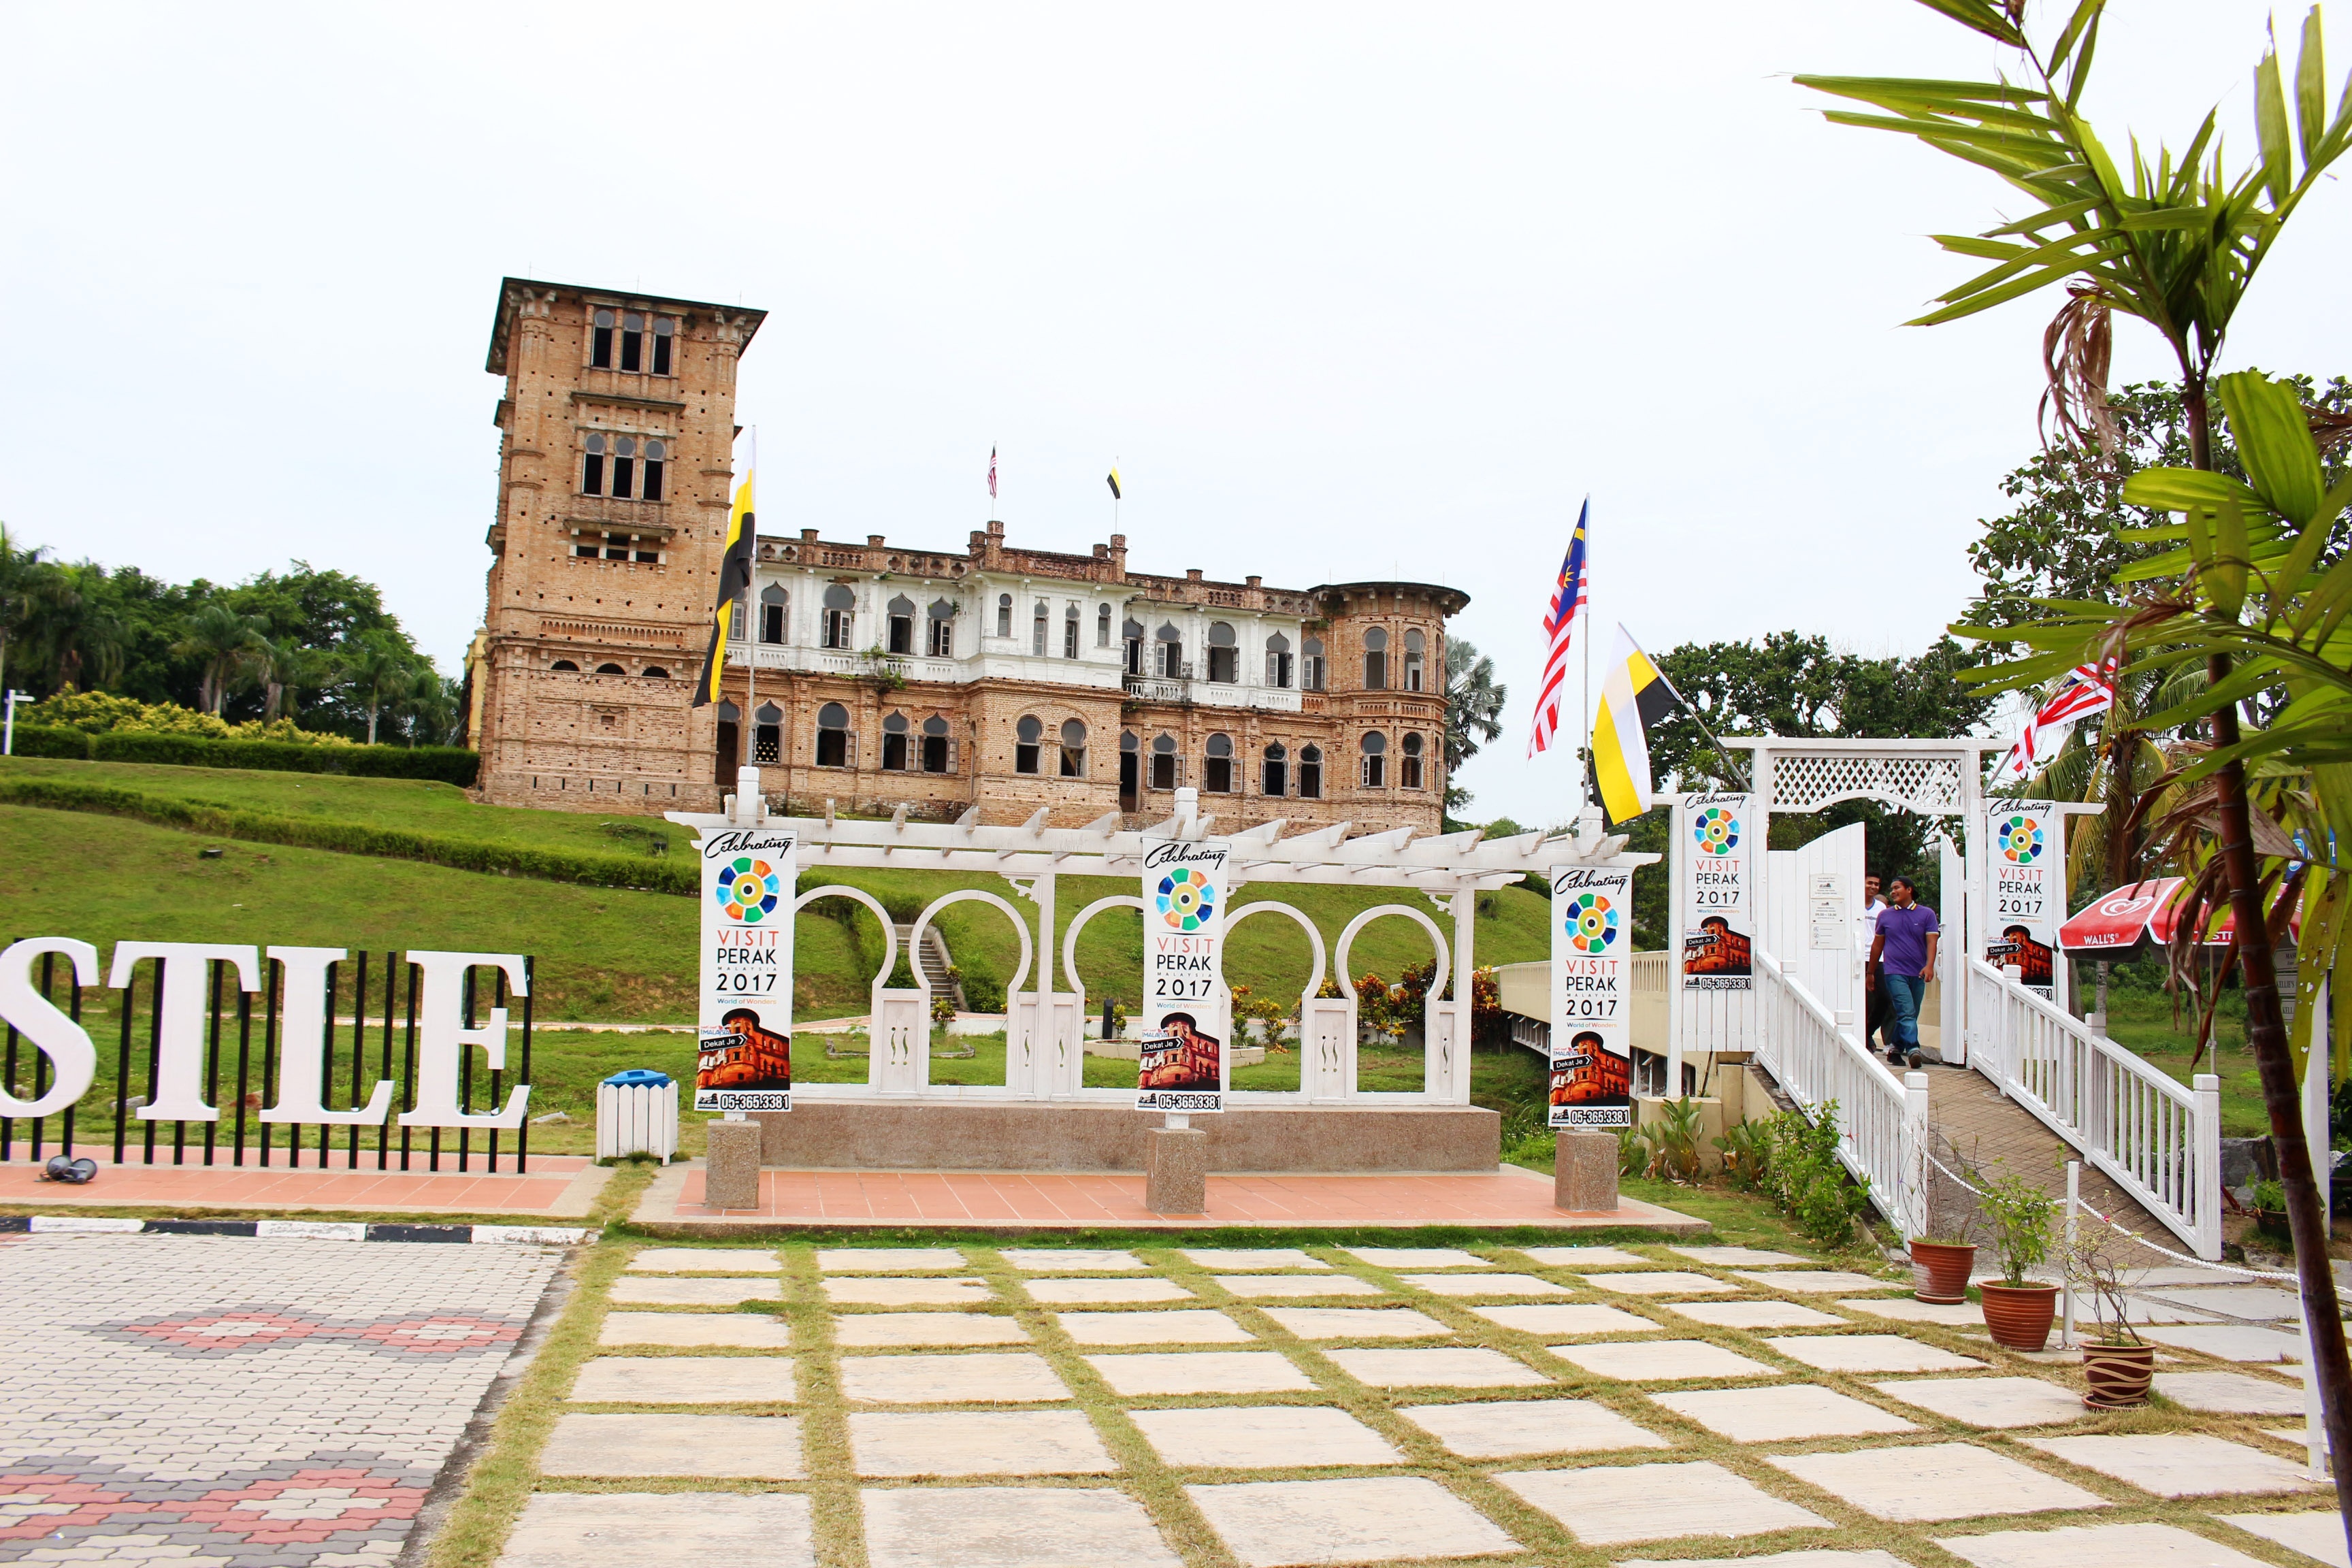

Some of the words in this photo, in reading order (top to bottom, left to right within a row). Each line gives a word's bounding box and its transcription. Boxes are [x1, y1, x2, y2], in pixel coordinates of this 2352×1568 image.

[1685, 793, 1747, 810] Celebrating
[1990, 798, 2053, 818] Celebrating
[705, 832, 794, 860] Celebrating
[1145, 843, 1227, 870] Celebrating
[1696, 860, 1740, 872] VISIT
[1697, 873, 1739, 884] PERAK
[1999, 868, 2043, 881] VISIT
[1554, 870, 1628, 896] Celebrating
[1999, 881, 2042, 894] PERAK
[1697, 892, 1739, 904] 2017
[1999, 900, 2042, 913] 2017
[718, 930, 779, 946] VISIT
[1157, 937, 1213, 953] VISIT
[2083, 933, 2115, 945] WALL'S
[717, 948, 776, 964] PERAK
[1157, 955, 1211, 970] PERAK
[1567, 960, 1618, 975] VISIT
[716, 973, 777, 991] 2017
[1156, 979, 1211, 996] 2017
[1567, 977, 1616, 991] PERAK
[1701, 977, 1751, 989] 05-365.3381
[1566, 1000, 1617, 1015] 2017
[0, 936, 532, 1129] STLE
[704, 1040, 725, 1048] Dekat
[1144, 1042, 1164, 1050] Dekat
[1556, 1060, 1574, 1068] Dekat
[721, 1094, 789, 1110] 05-365.3381
[1158, 1094, 1221, 1109] 05-365.3381
[1571, 1109, 1629, 1124] 05-365.3381
